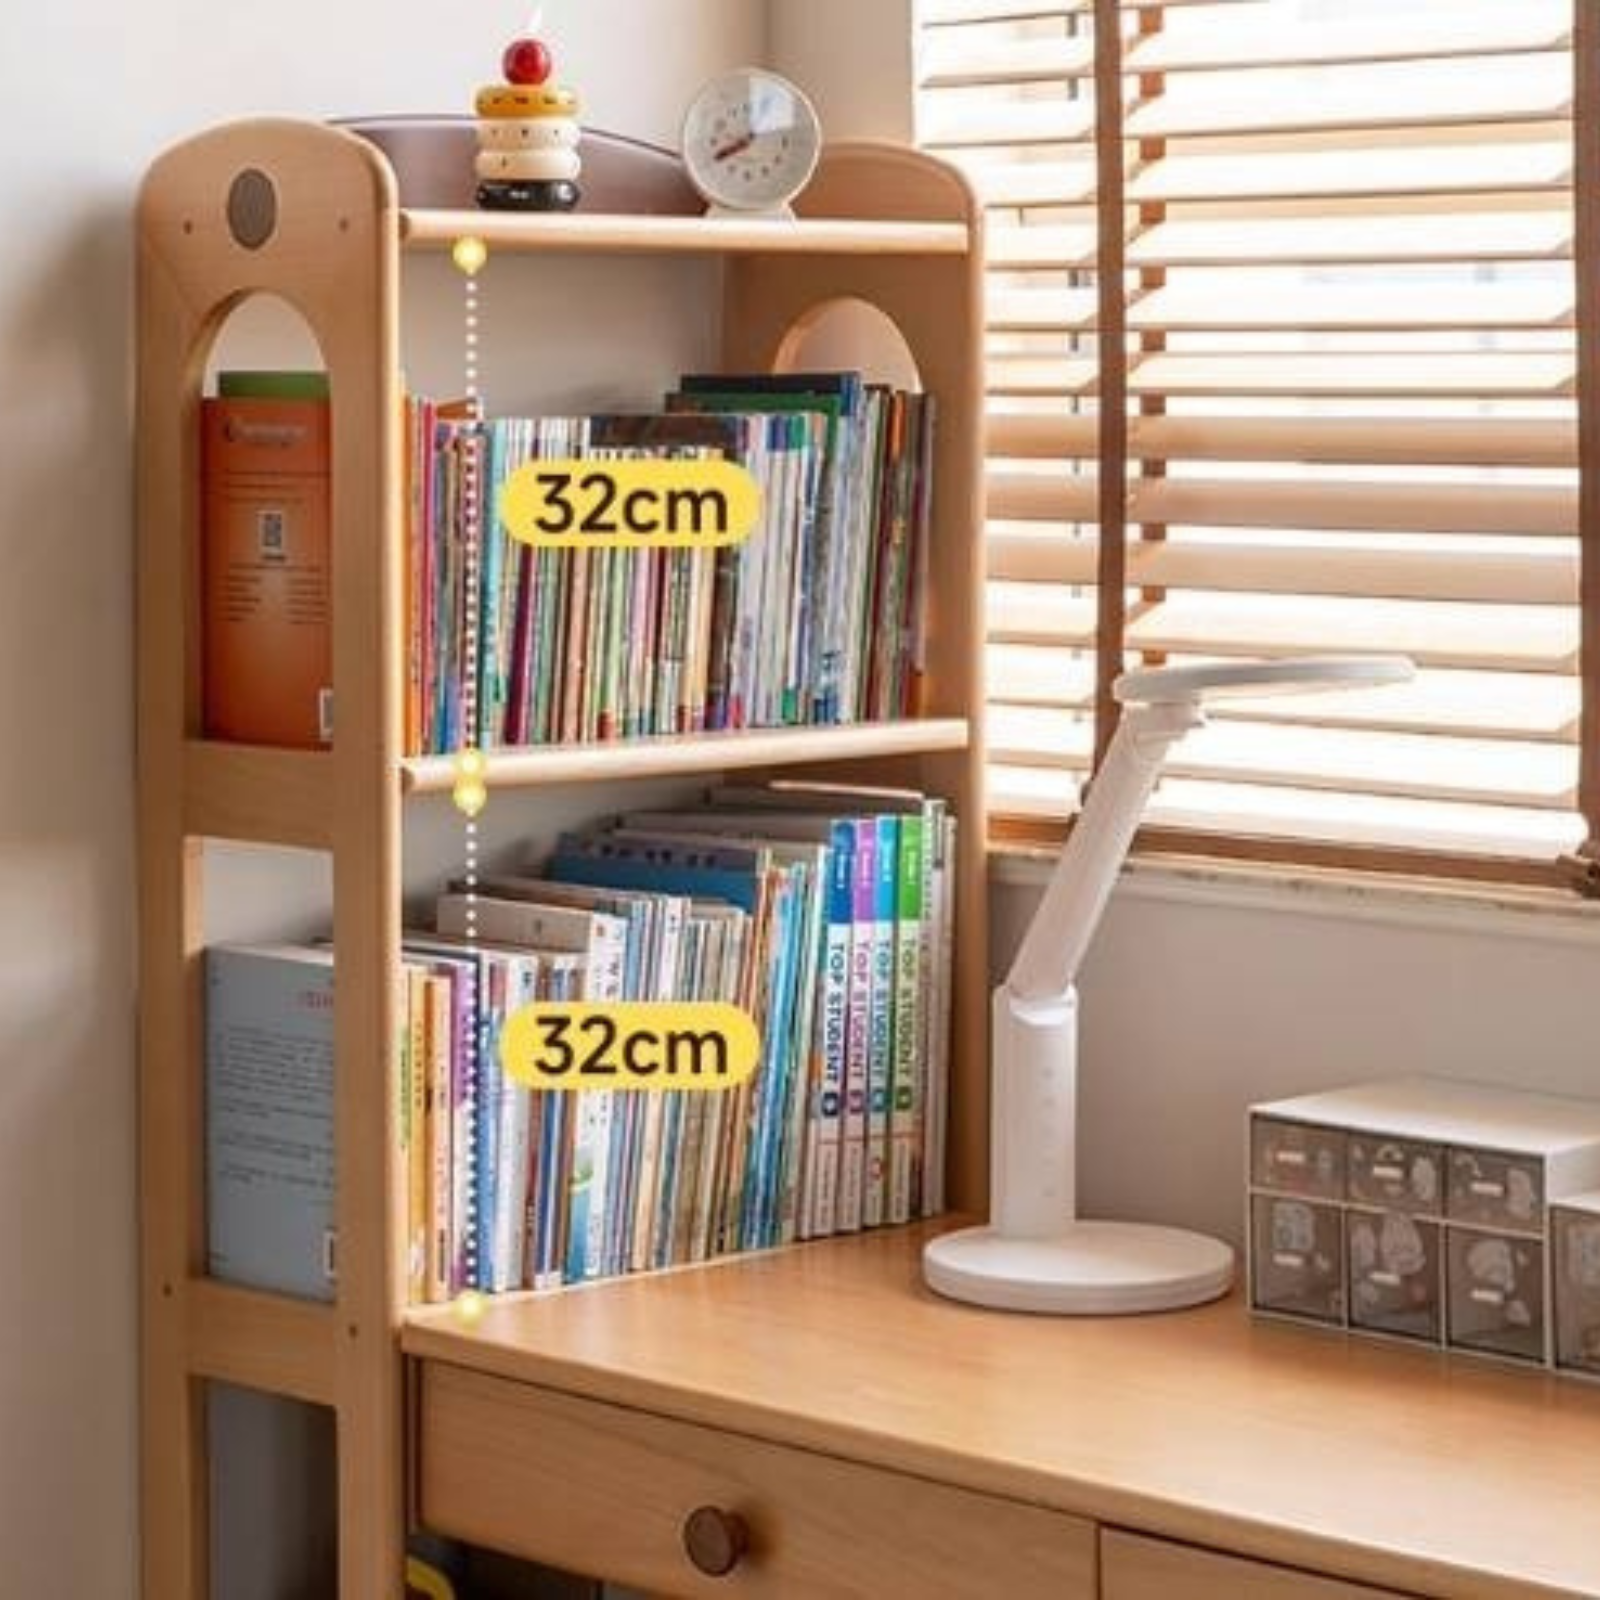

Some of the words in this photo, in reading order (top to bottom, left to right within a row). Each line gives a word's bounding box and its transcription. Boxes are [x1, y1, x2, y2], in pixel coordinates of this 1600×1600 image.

[830, 942, 844, 985] TOP
[855, 941, 869, 983] TOP
[876, 940, 890, 980] TOP
[901, 940, 915, 980] TOP
[826, 991, 842, 1082] STUDENT
[851, 992, 867, 1078] STUDENT
[871, 988, 887, 1077] STUDENT
[898, 989, 914, 1077] STUDENT
